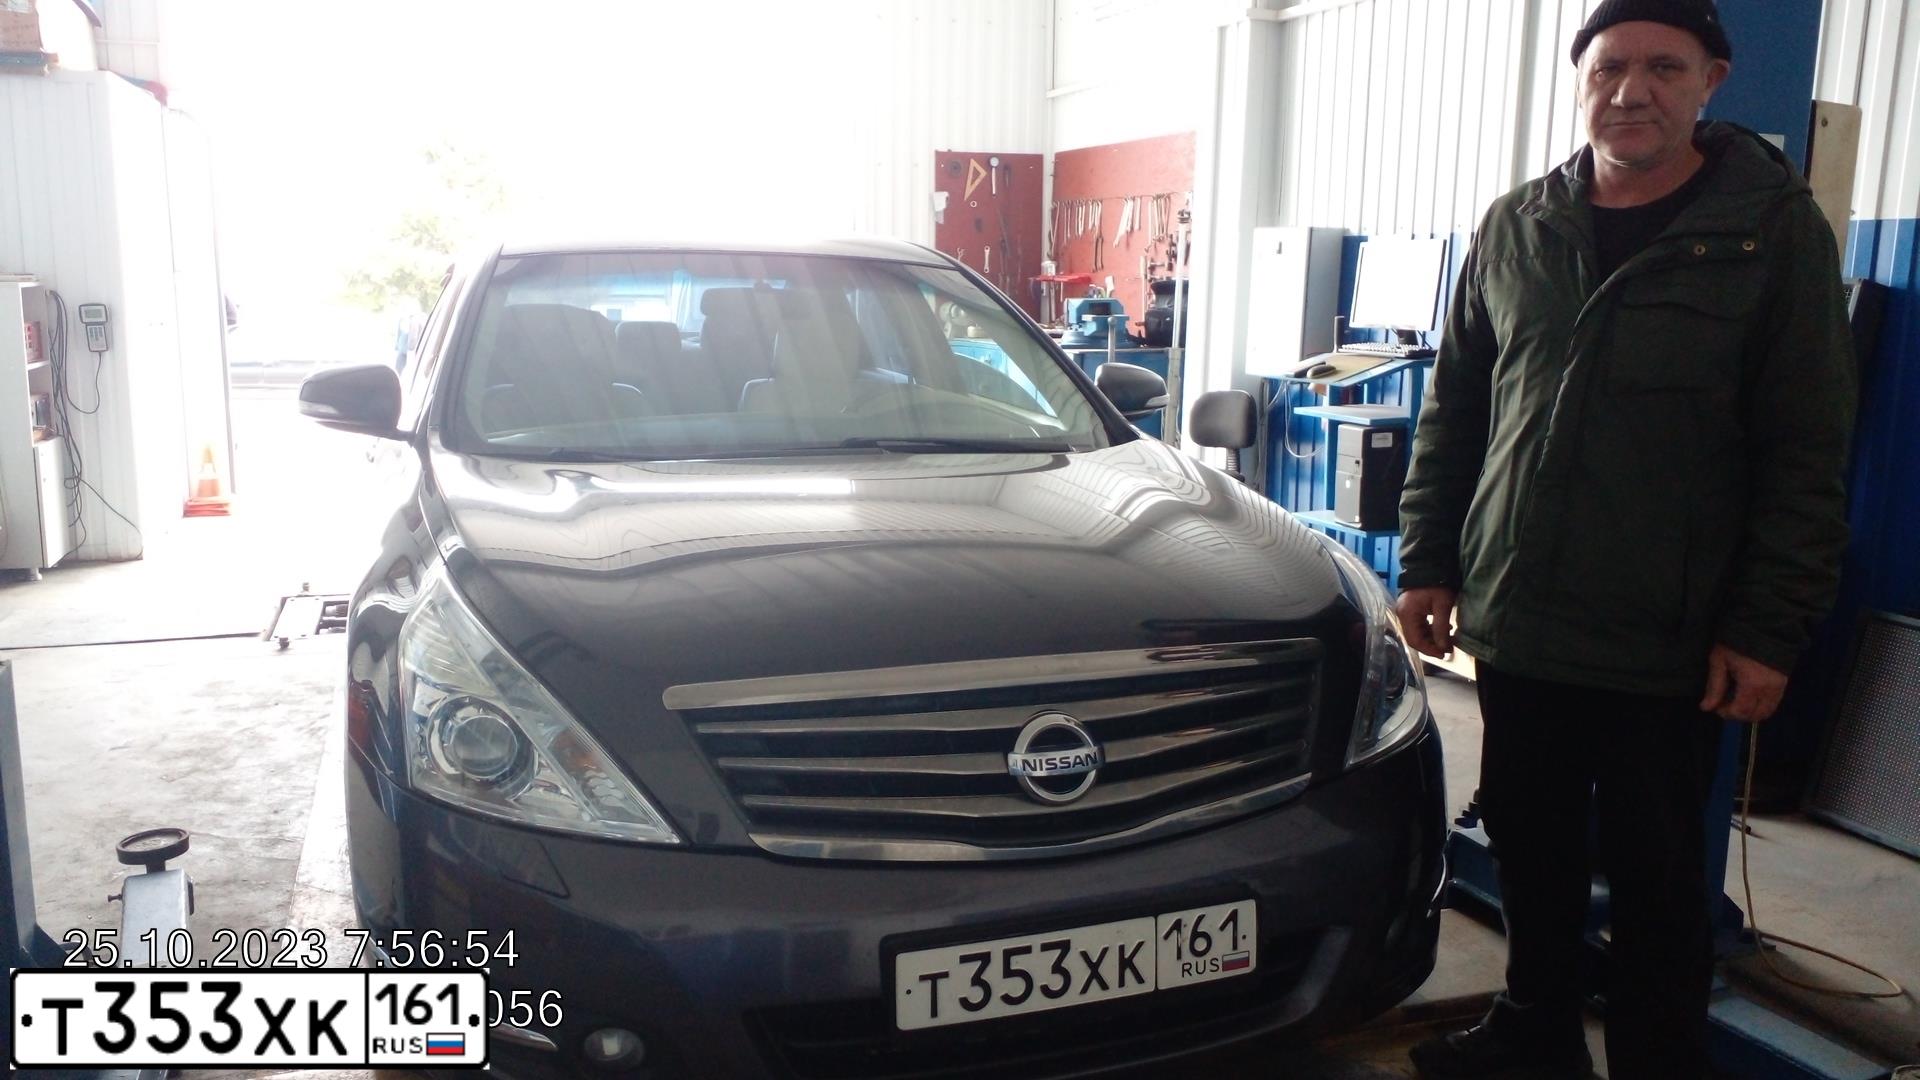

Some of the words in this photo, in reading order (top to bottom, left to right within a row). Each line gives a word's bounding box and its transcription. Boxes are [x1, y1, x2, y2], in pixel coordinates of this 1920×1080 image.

[1021, 751, 1098, 772] NISSAN
[1162, 908, 1239, 961] 161
[918, 938, 1146, 1019] Т353ХК
[1181, 958, 1220, 978] RUS
